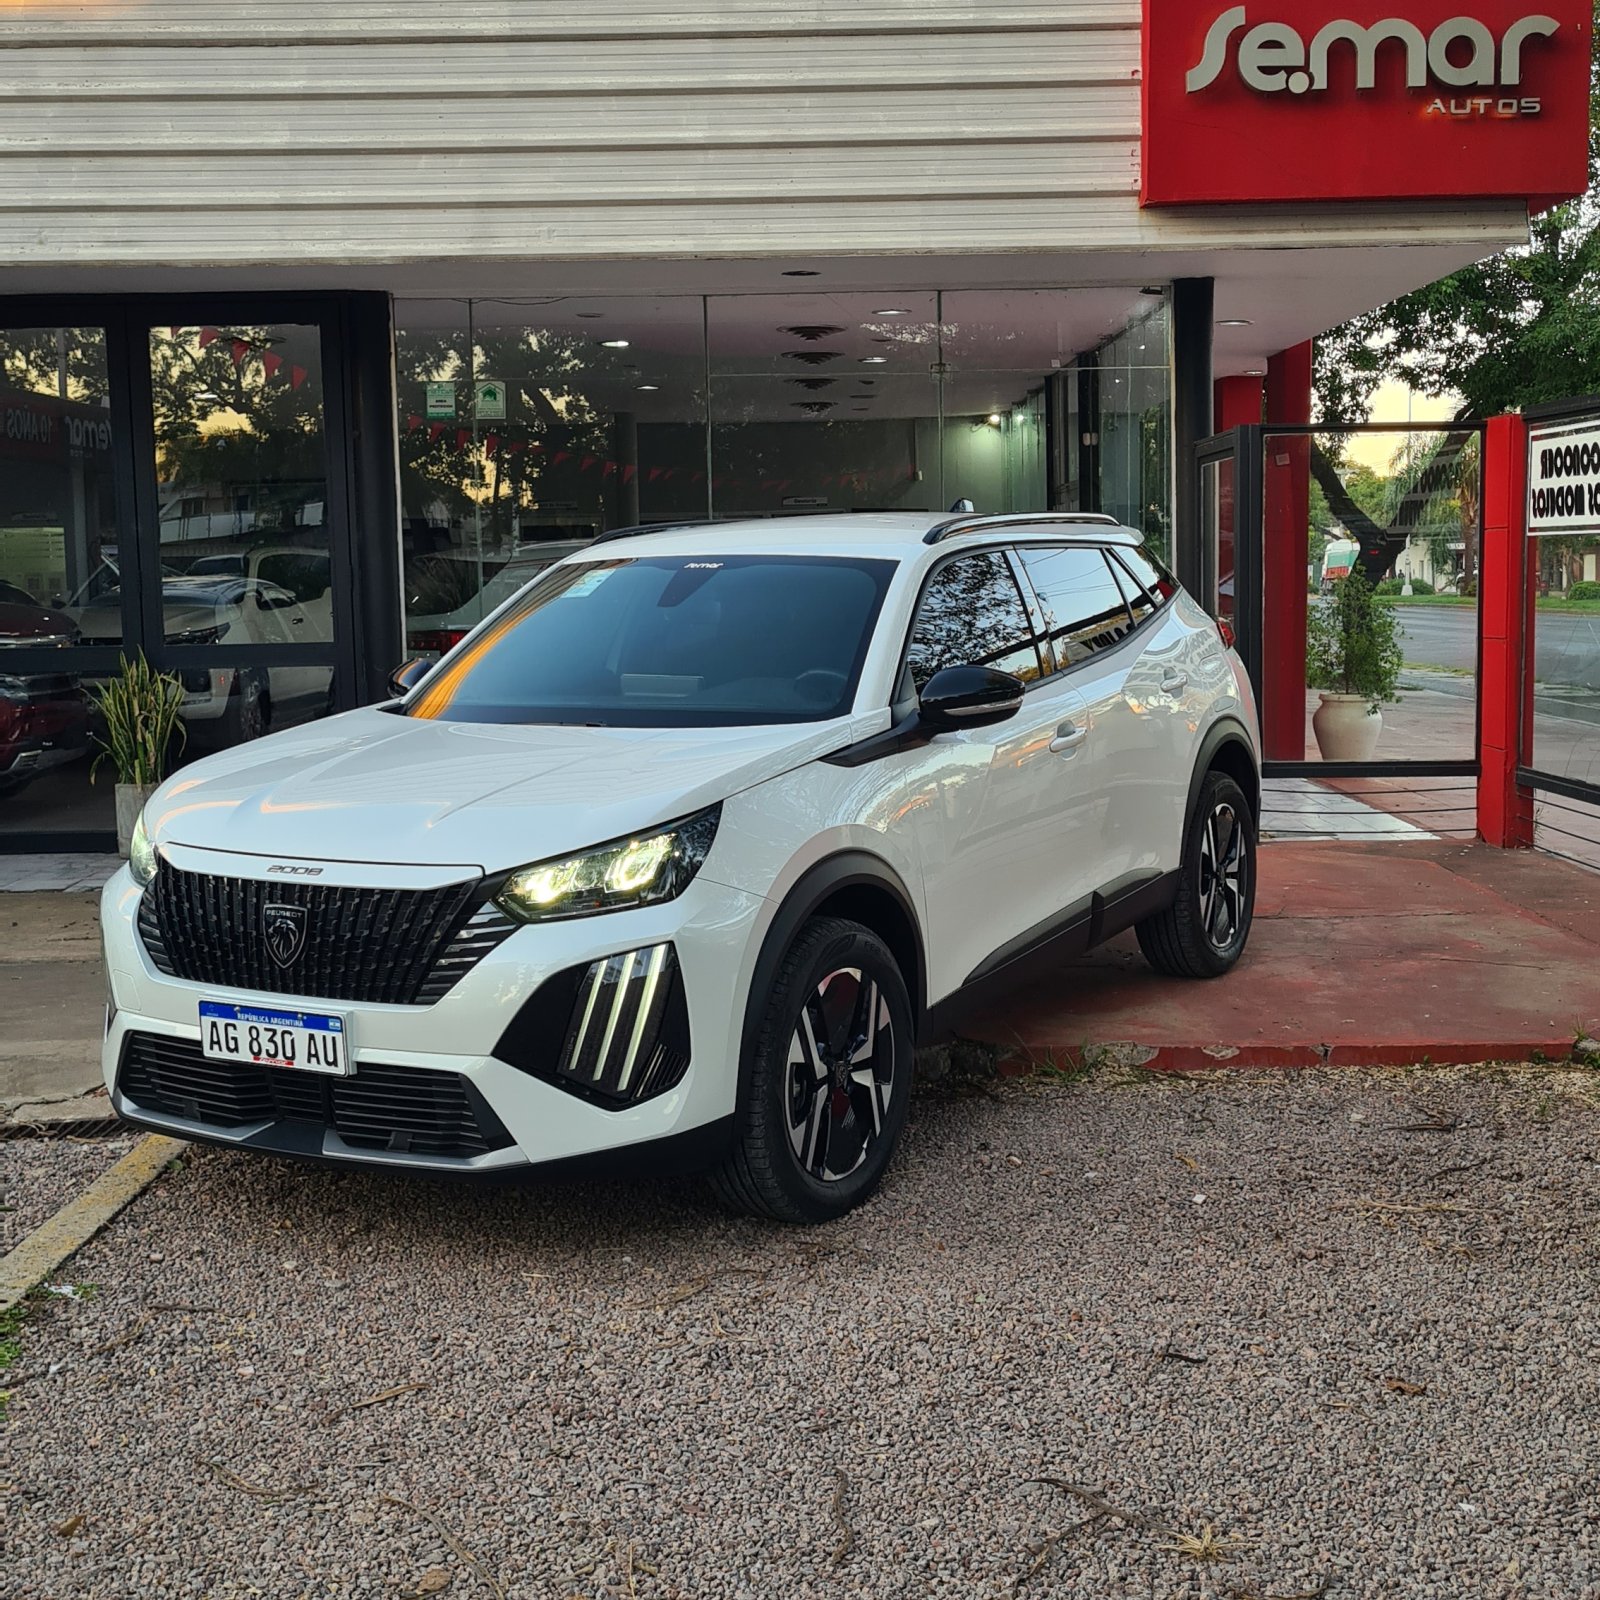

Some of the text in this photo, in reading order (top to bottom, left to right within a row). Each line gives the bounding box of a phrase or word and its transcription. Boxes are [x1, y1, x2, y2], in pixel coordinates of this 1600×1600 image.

[1425, 97, 1541, 114] AUTOS
[266, 865, 324, 876] 2008
[266, 910, 303, 918] PEUGEOT
[237, 1012, 304, 1027] REPÚBLICA ARGENTINA
[209, 1021, 339, 1068] AG 830 AU
